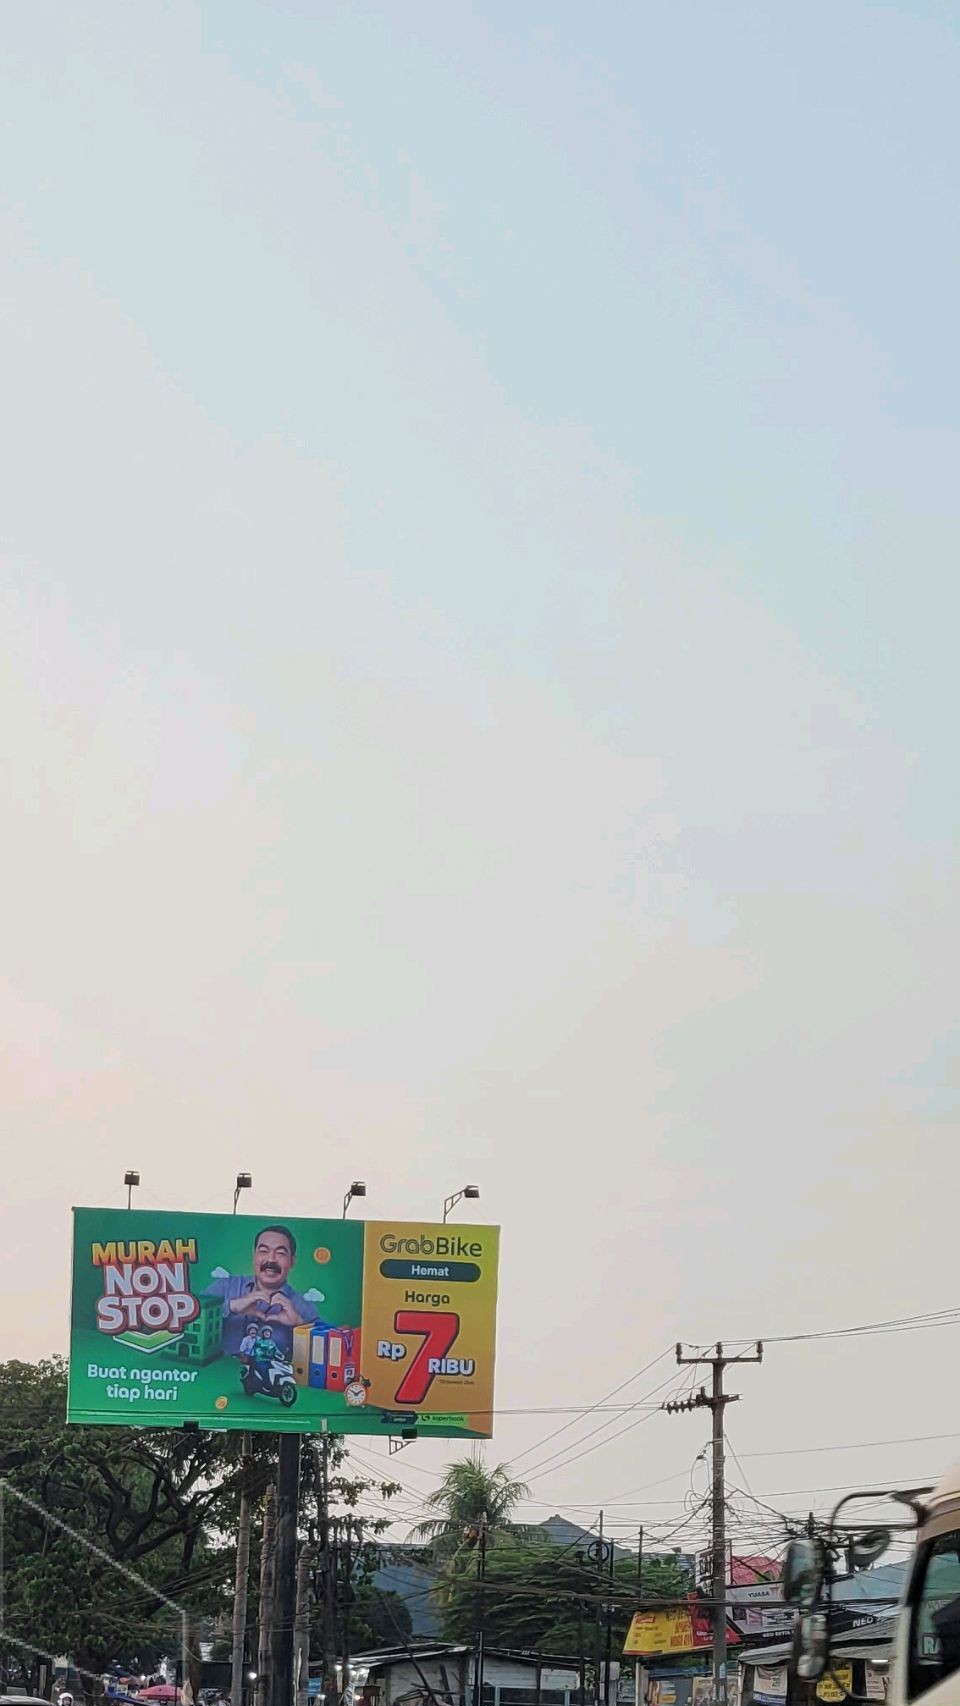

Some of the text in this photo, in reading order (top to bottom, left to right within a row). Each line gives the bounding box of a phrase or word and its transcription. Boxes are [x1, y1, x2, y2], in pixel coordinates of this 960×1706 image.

[91, 1239, 198, 1267] MURAH
[380, 1234, 483, 1258] GrabBike
[104, 1263, 187, 1297] NON
[411, 1264, 449, 1278] Hemat
[405, 1290, 450, 1307] Harga
[97, 1295, 199, 1332] STOP
[377, 1310, 460, 1405] Rp 7
[428, 1358, 475, 1376] RIBU
[87, 1364, 197, 1385] Buat ngantor
[106, 1384, 178, 1401] tiap hari
[852, 1616, 874, 1628] NEO
